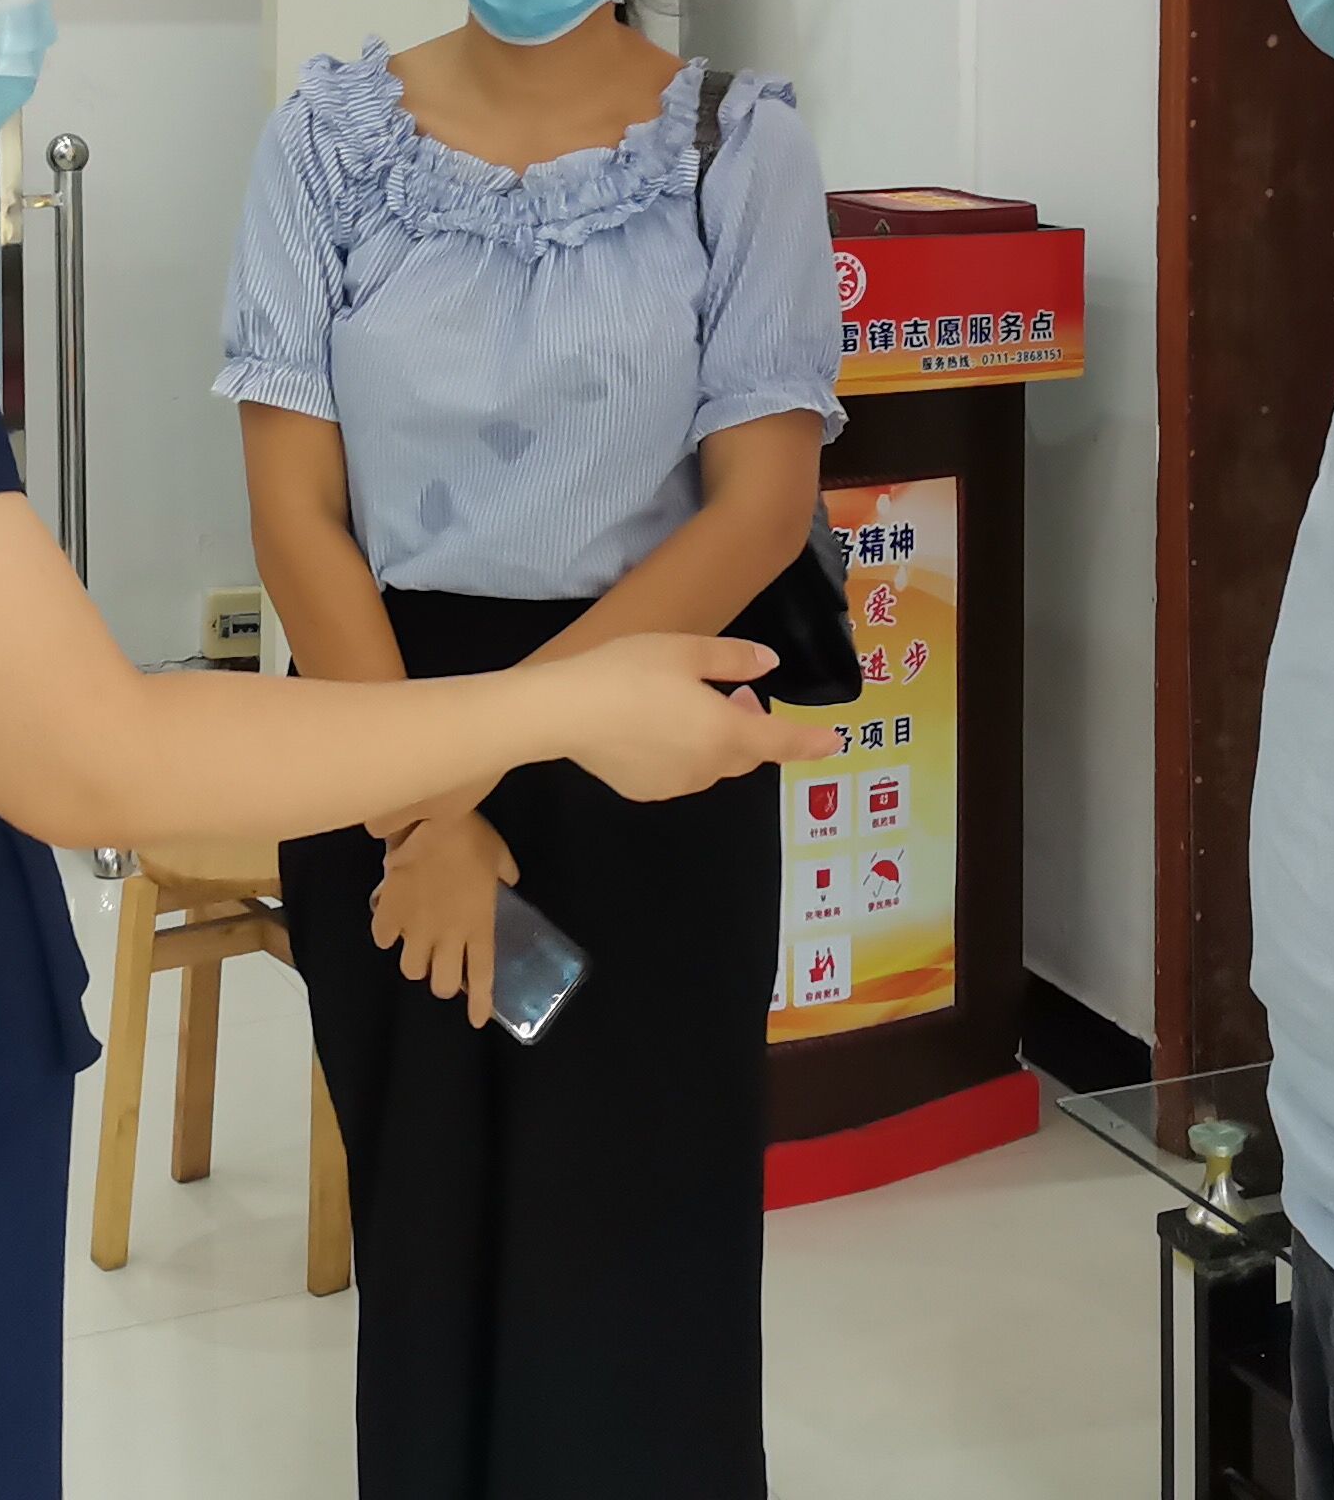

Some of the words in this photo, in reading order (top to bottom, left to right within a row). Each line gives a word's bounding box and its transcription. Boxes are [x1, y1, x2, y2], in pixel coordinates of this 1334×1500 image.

[841, 311, 1054, 352] 雷锋志愿服务点
[861, 641, 928, 683] 进步
